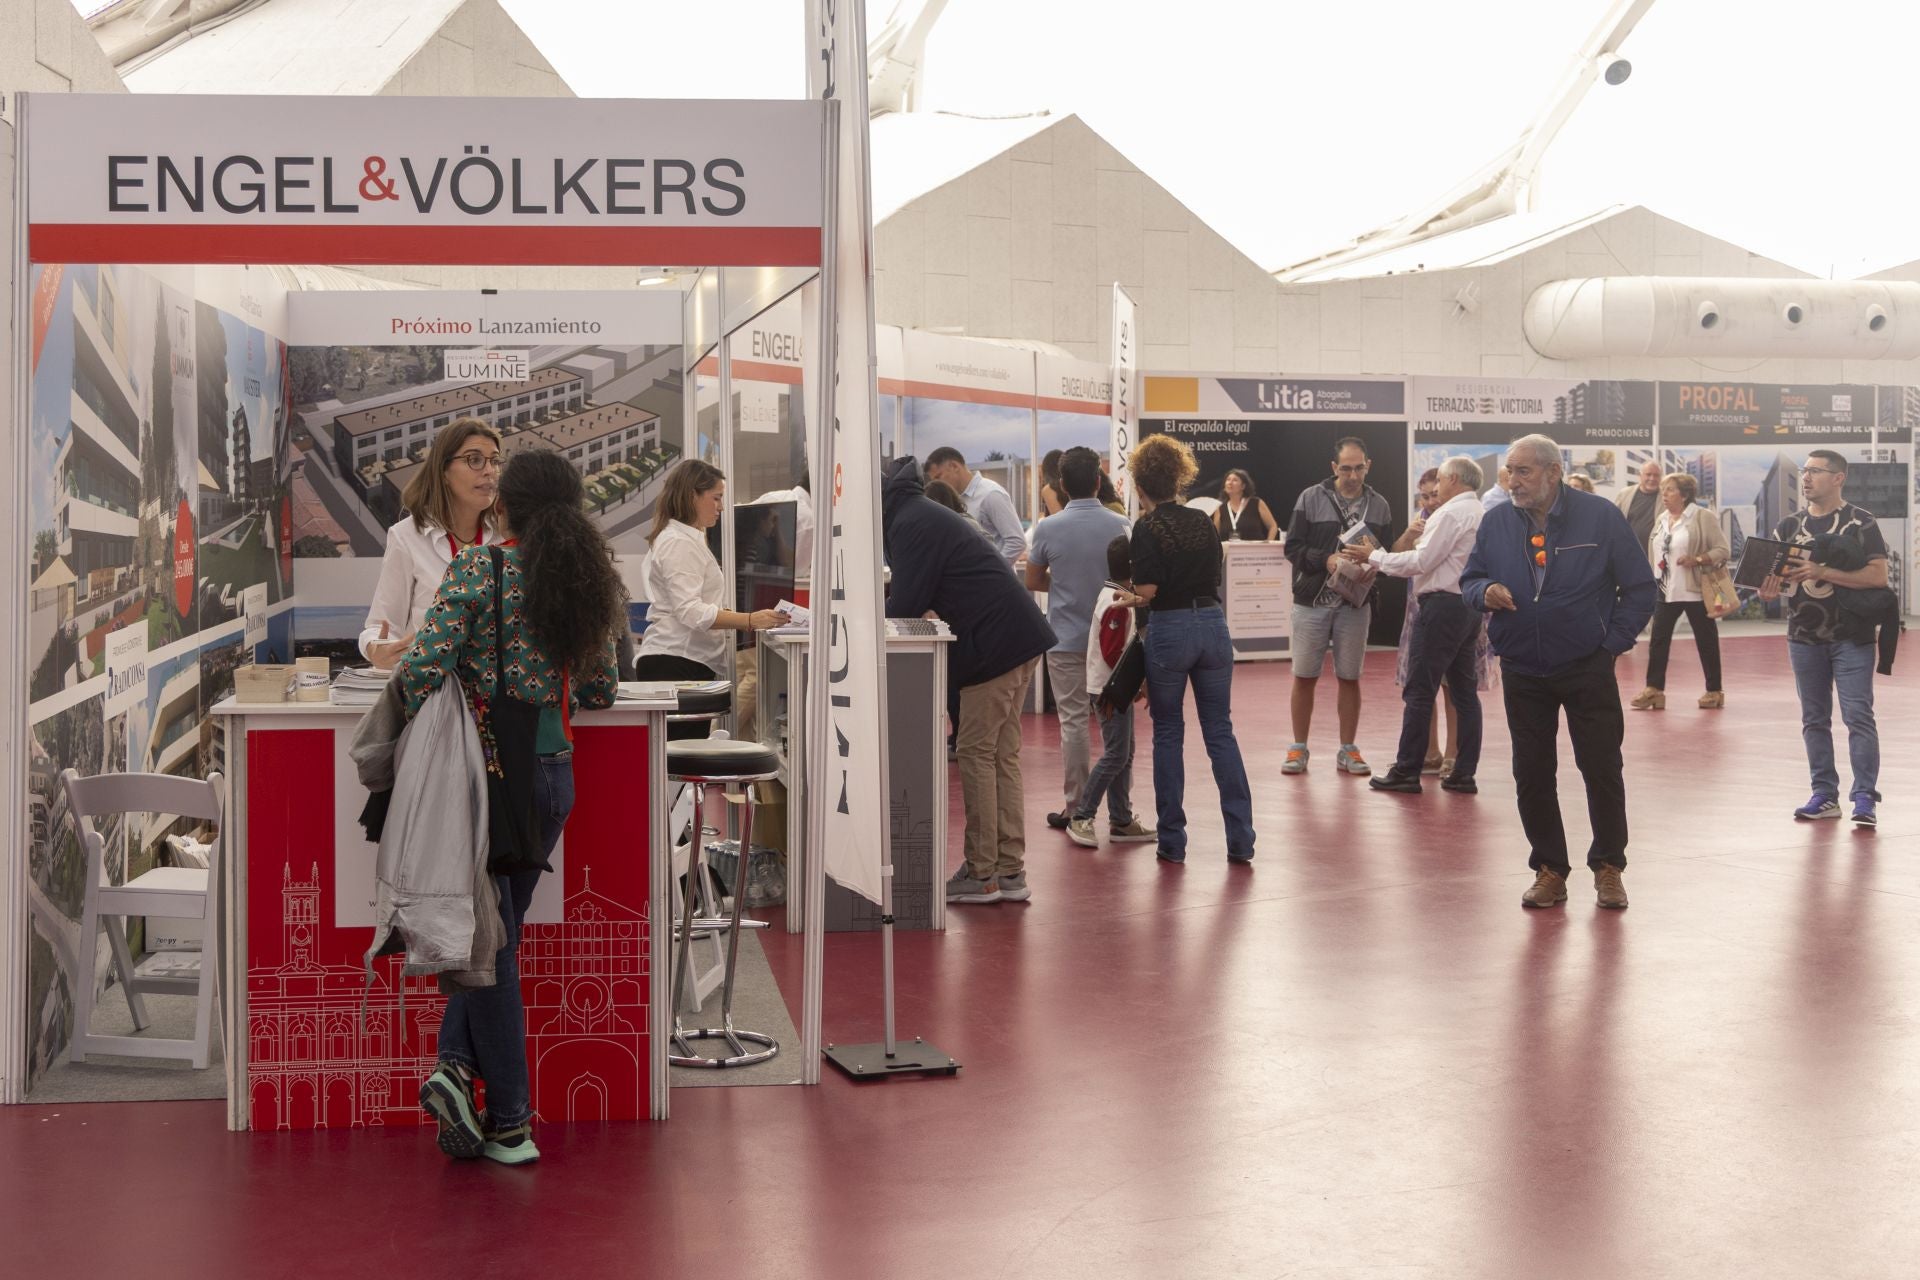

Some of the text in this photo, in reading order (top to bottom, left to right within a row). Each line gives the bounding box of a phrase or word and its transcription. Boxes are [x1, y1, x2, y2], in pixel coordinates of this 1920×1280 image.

[107, 145, 747, 215] ENGEL&VÖLKERS
[391, 317, 602, 334] Próximo Lanzamiento
[447, 363, 526, 379] LUMINE
[1258, 383, 1314, 410] Litia
[1455, 383, 1517, 396] RESIDENCIAL
[1426, 397, 1543, 415] TERRAZAS VICTORIA
[1679, 385, 1760, 412] PROFAL
[1689, 414, 1749, 424] PROMOCIONES
[1164, 420, 1250, 436] El respaldo legal
[1585, 428, 1650, 438] PROMOCIONES
